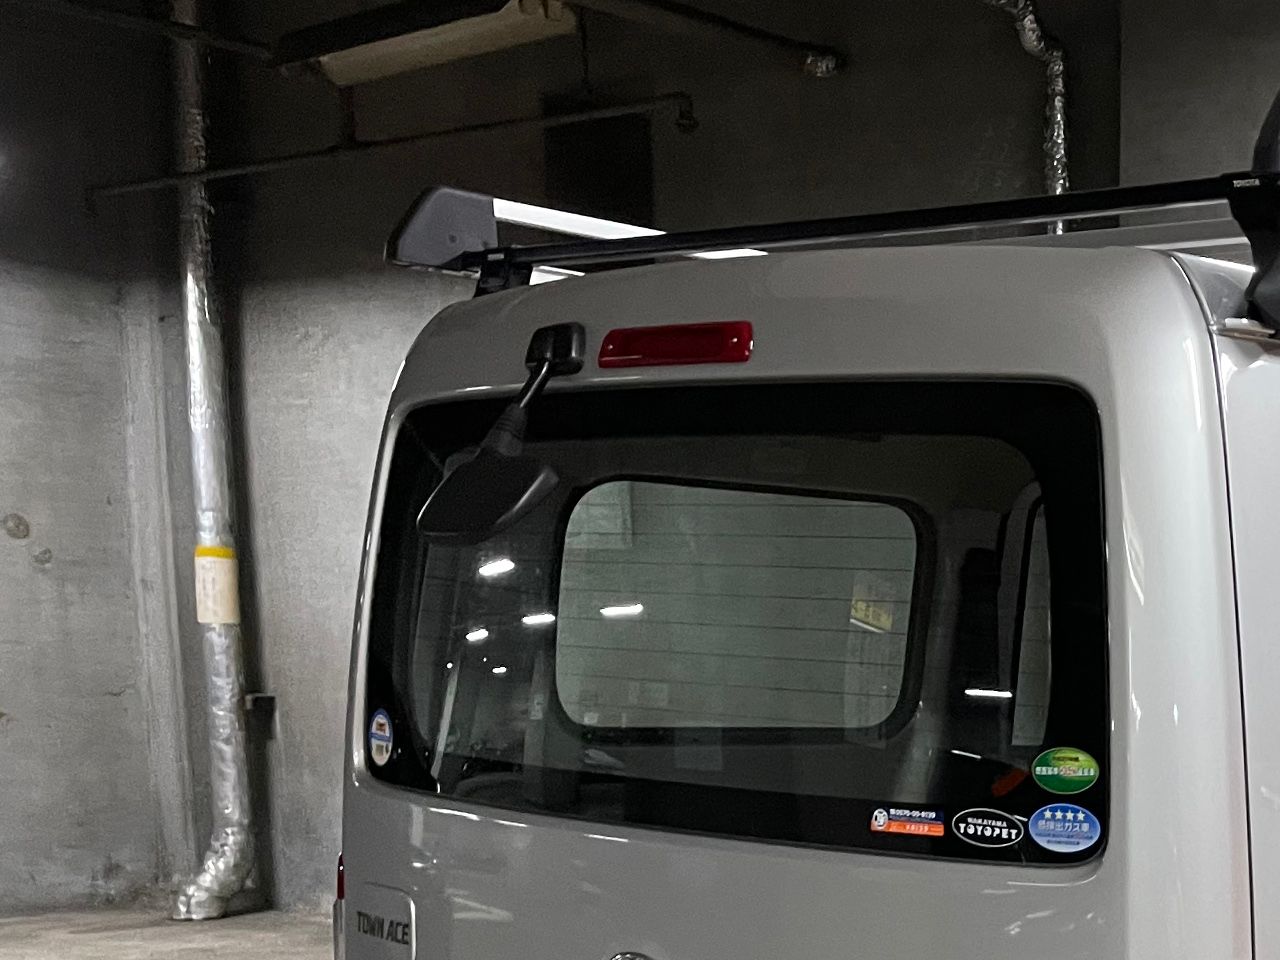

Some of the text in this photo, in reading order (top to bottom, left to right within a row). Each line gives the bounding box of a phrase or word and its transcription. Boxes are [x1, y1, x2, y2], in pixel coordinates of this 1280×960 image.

[958, 823, 1018, 840] TOYOPET
[357, 911, 409, 945] TOWN ACE
